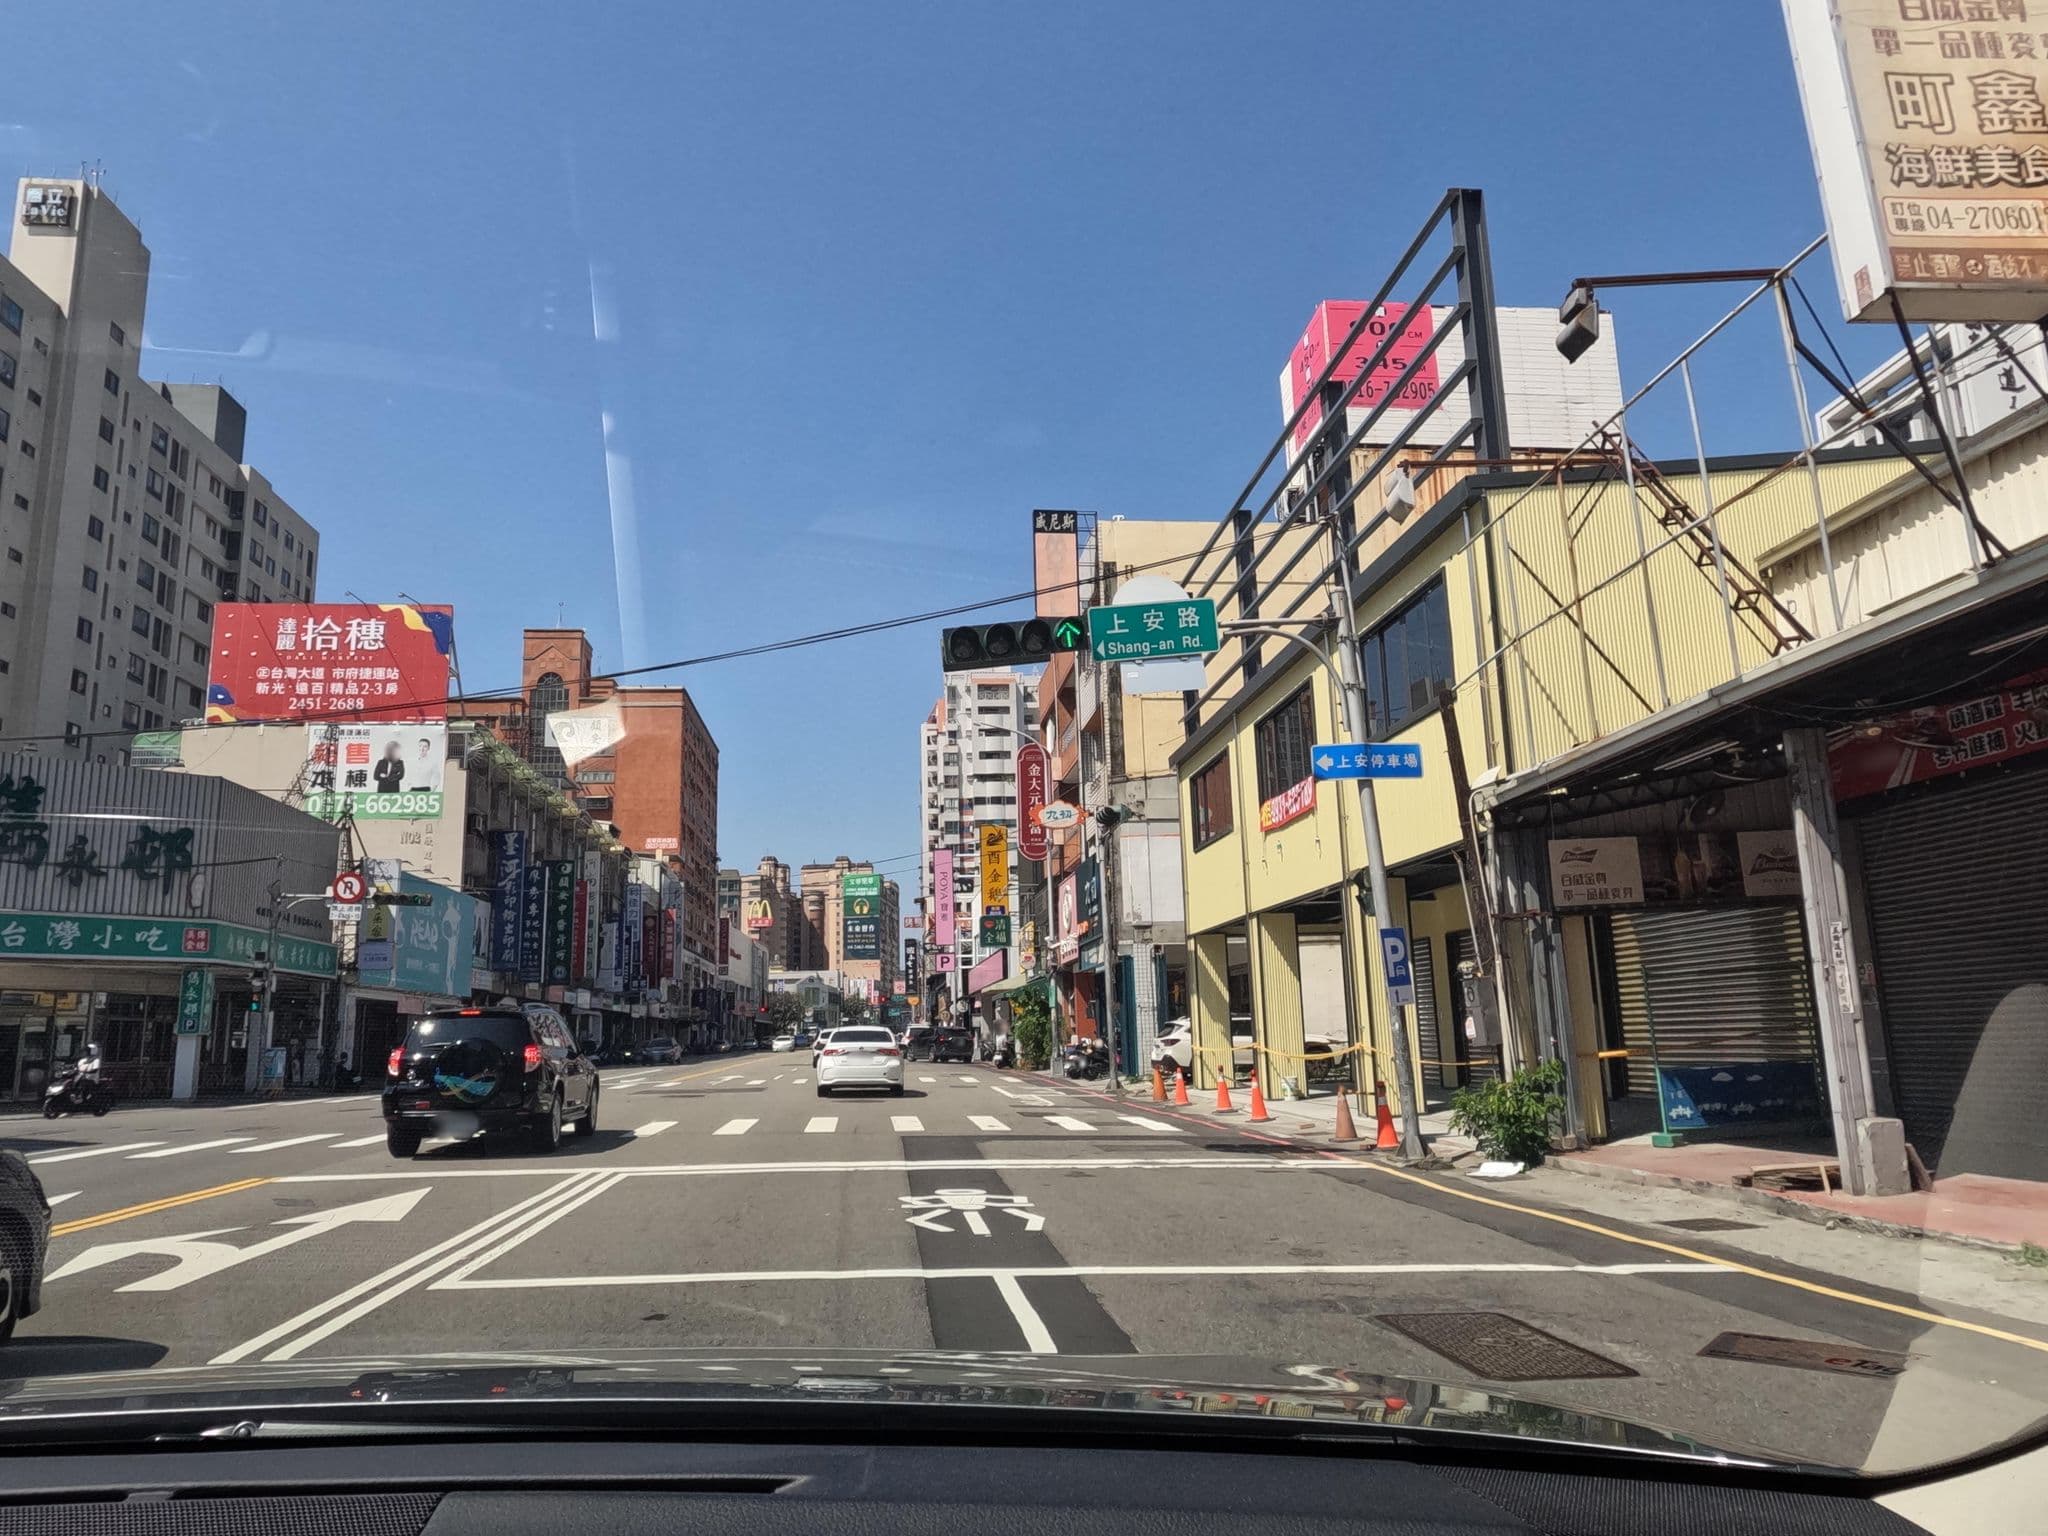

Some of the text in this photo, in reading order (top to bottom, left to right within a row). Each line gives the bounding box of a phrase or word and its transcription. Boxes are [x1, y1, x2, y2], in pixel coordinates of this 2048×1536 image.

[1872, 28, 2048, 59] 單一品種麥
[1884, 70, 2048, 134] 町鑫
[1885, 142, 2048, 188] 海鮮美食
[1891, 203, 1922, 216] 訂位
[1408, 330, 1422, 339] CM
[1355, 357, 1407, 370] 345
[1343, 380, 1436, 399] 16-72905
[1035, 512, 1075, 532] 威尼斯
[1106, 606, 1200, 635] 上安路
[276, 616, 387, 651] 達麗 拾穗
[1108, 634, 1204, 655] Shang-an Rd.
[332, 666, 399, 680] 市府捷運站
[288, 697, 364, 710] 2451-2688
[1337, 753, 1418, 768] 上安停車場
[307, 794, 440, 815] 075-662985
[1028, 763, 1042, 835] 金大元富
[940, 871, 948, 900] POYA
[1, 920, 168, 951] 台灣小吃
[940, 956, 950, 968] P
[1384, 936, 1406, 978] P
